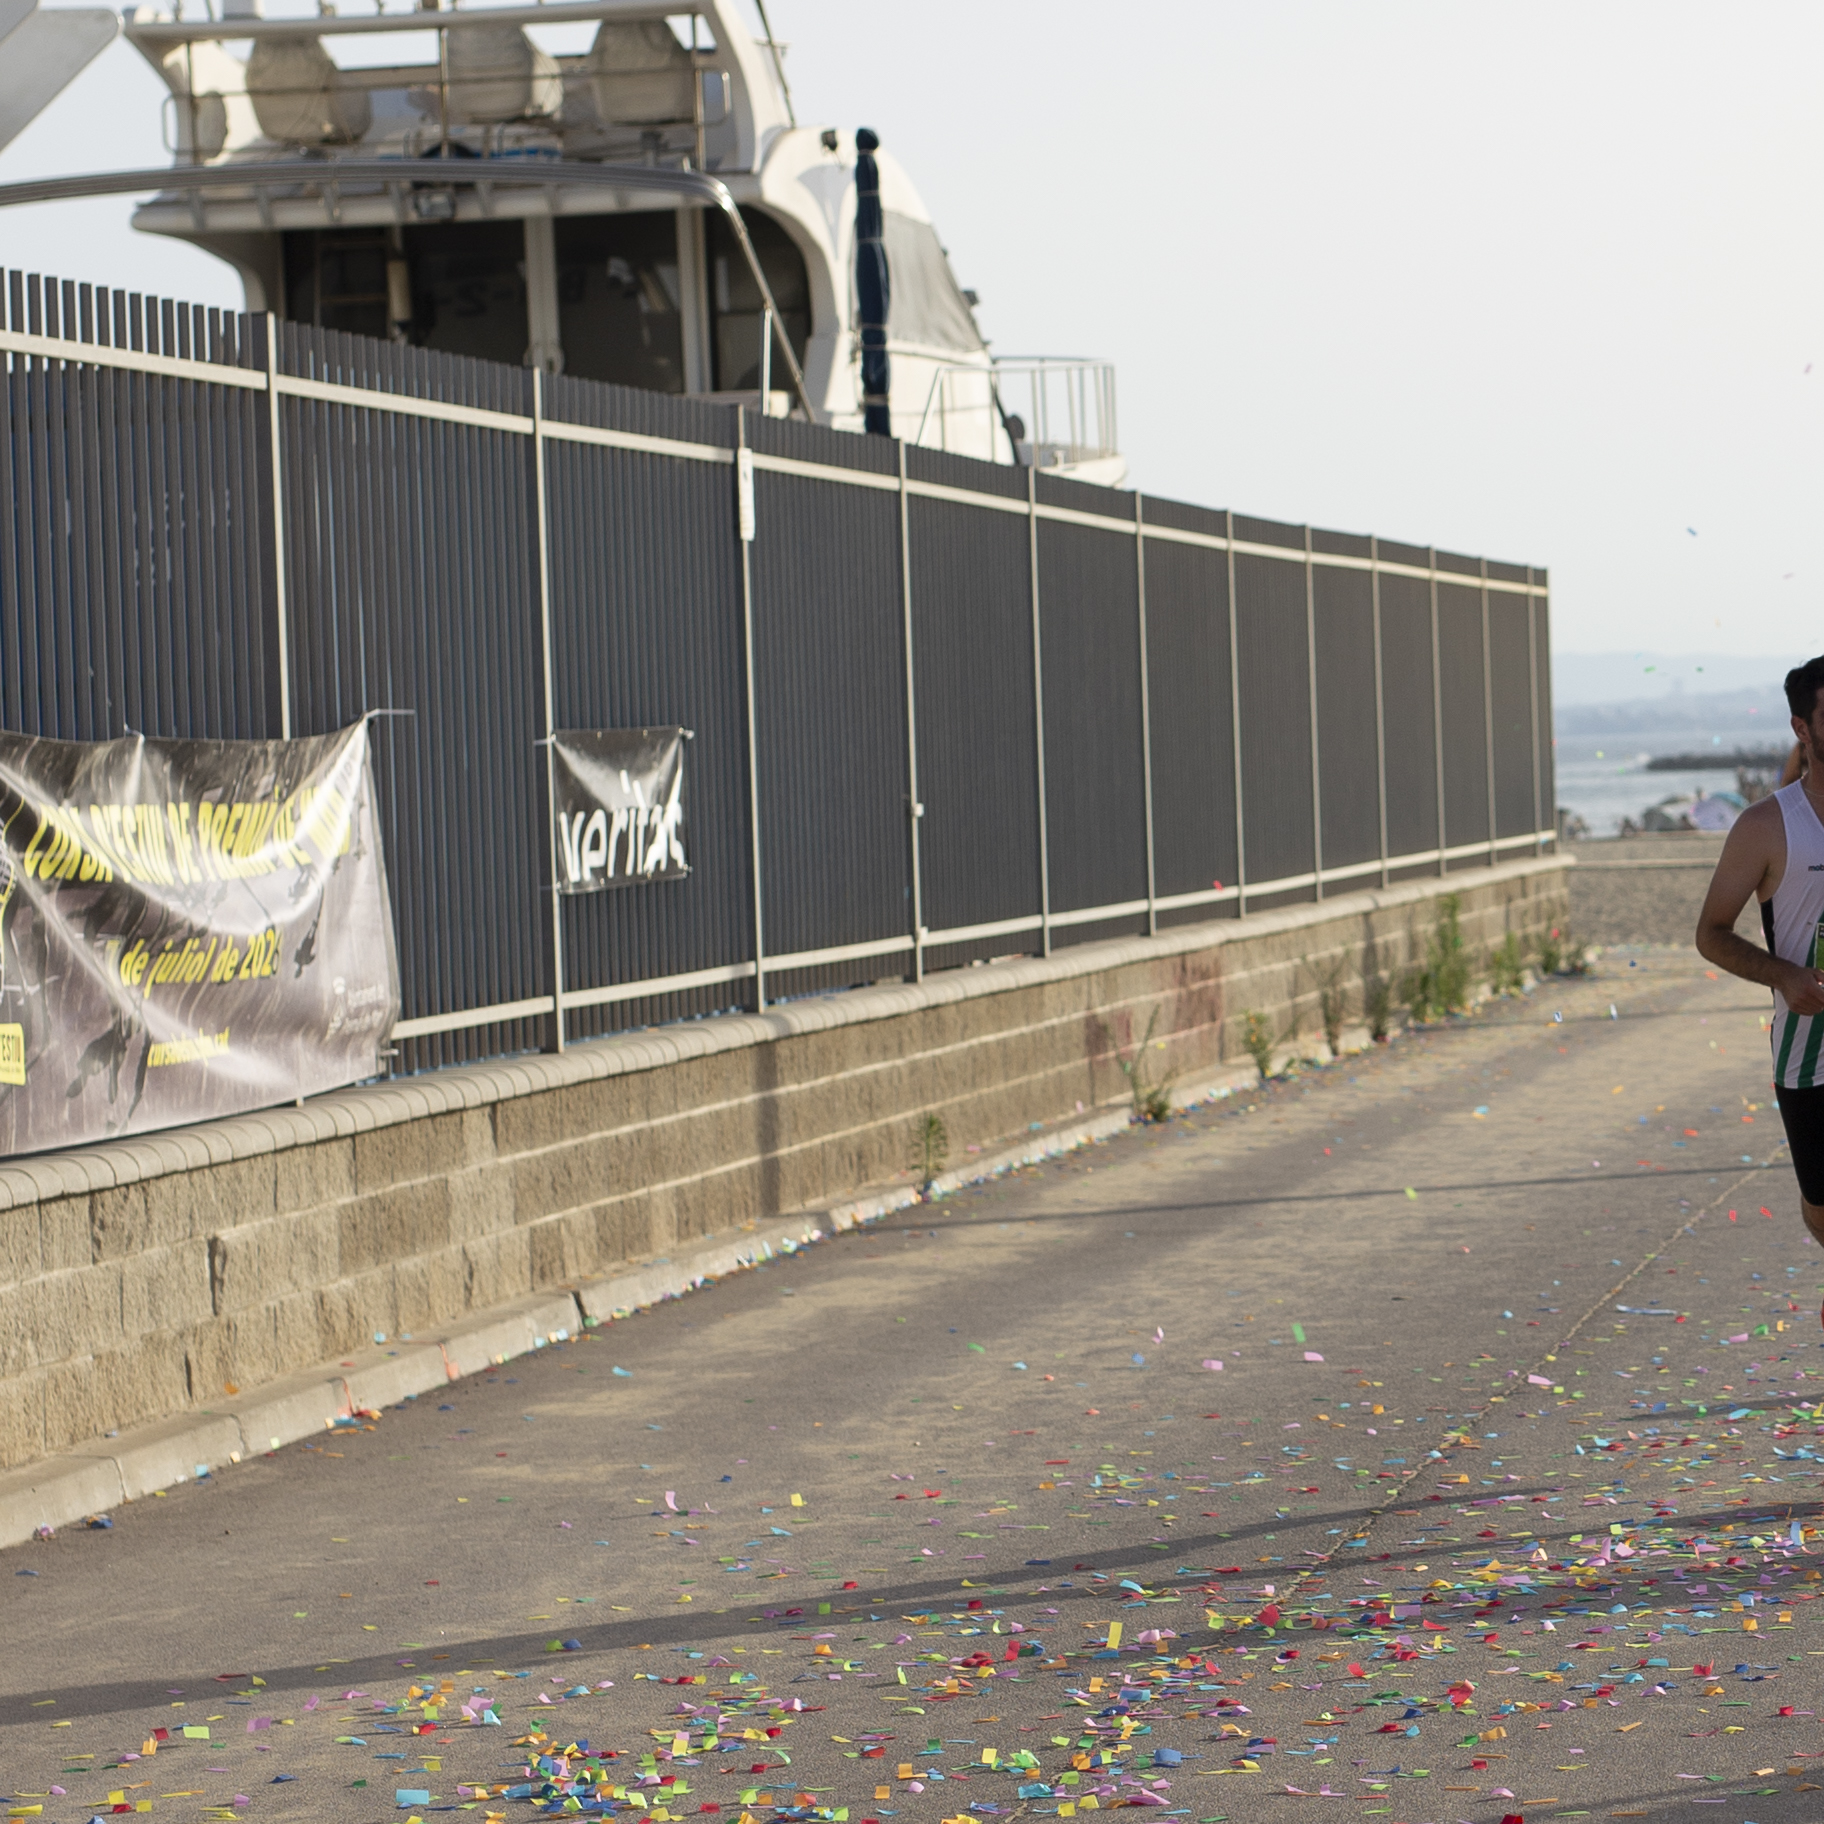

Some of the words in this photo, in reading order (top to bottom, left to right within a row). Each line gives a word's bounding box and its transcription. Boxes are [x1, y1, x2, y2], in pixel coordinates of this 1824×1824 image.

[167, 801, 203, 885] DE
[120, 938, 149, 987] de
[144, 937, 218, 999] juliol
[211, 935, 240, 984] de
